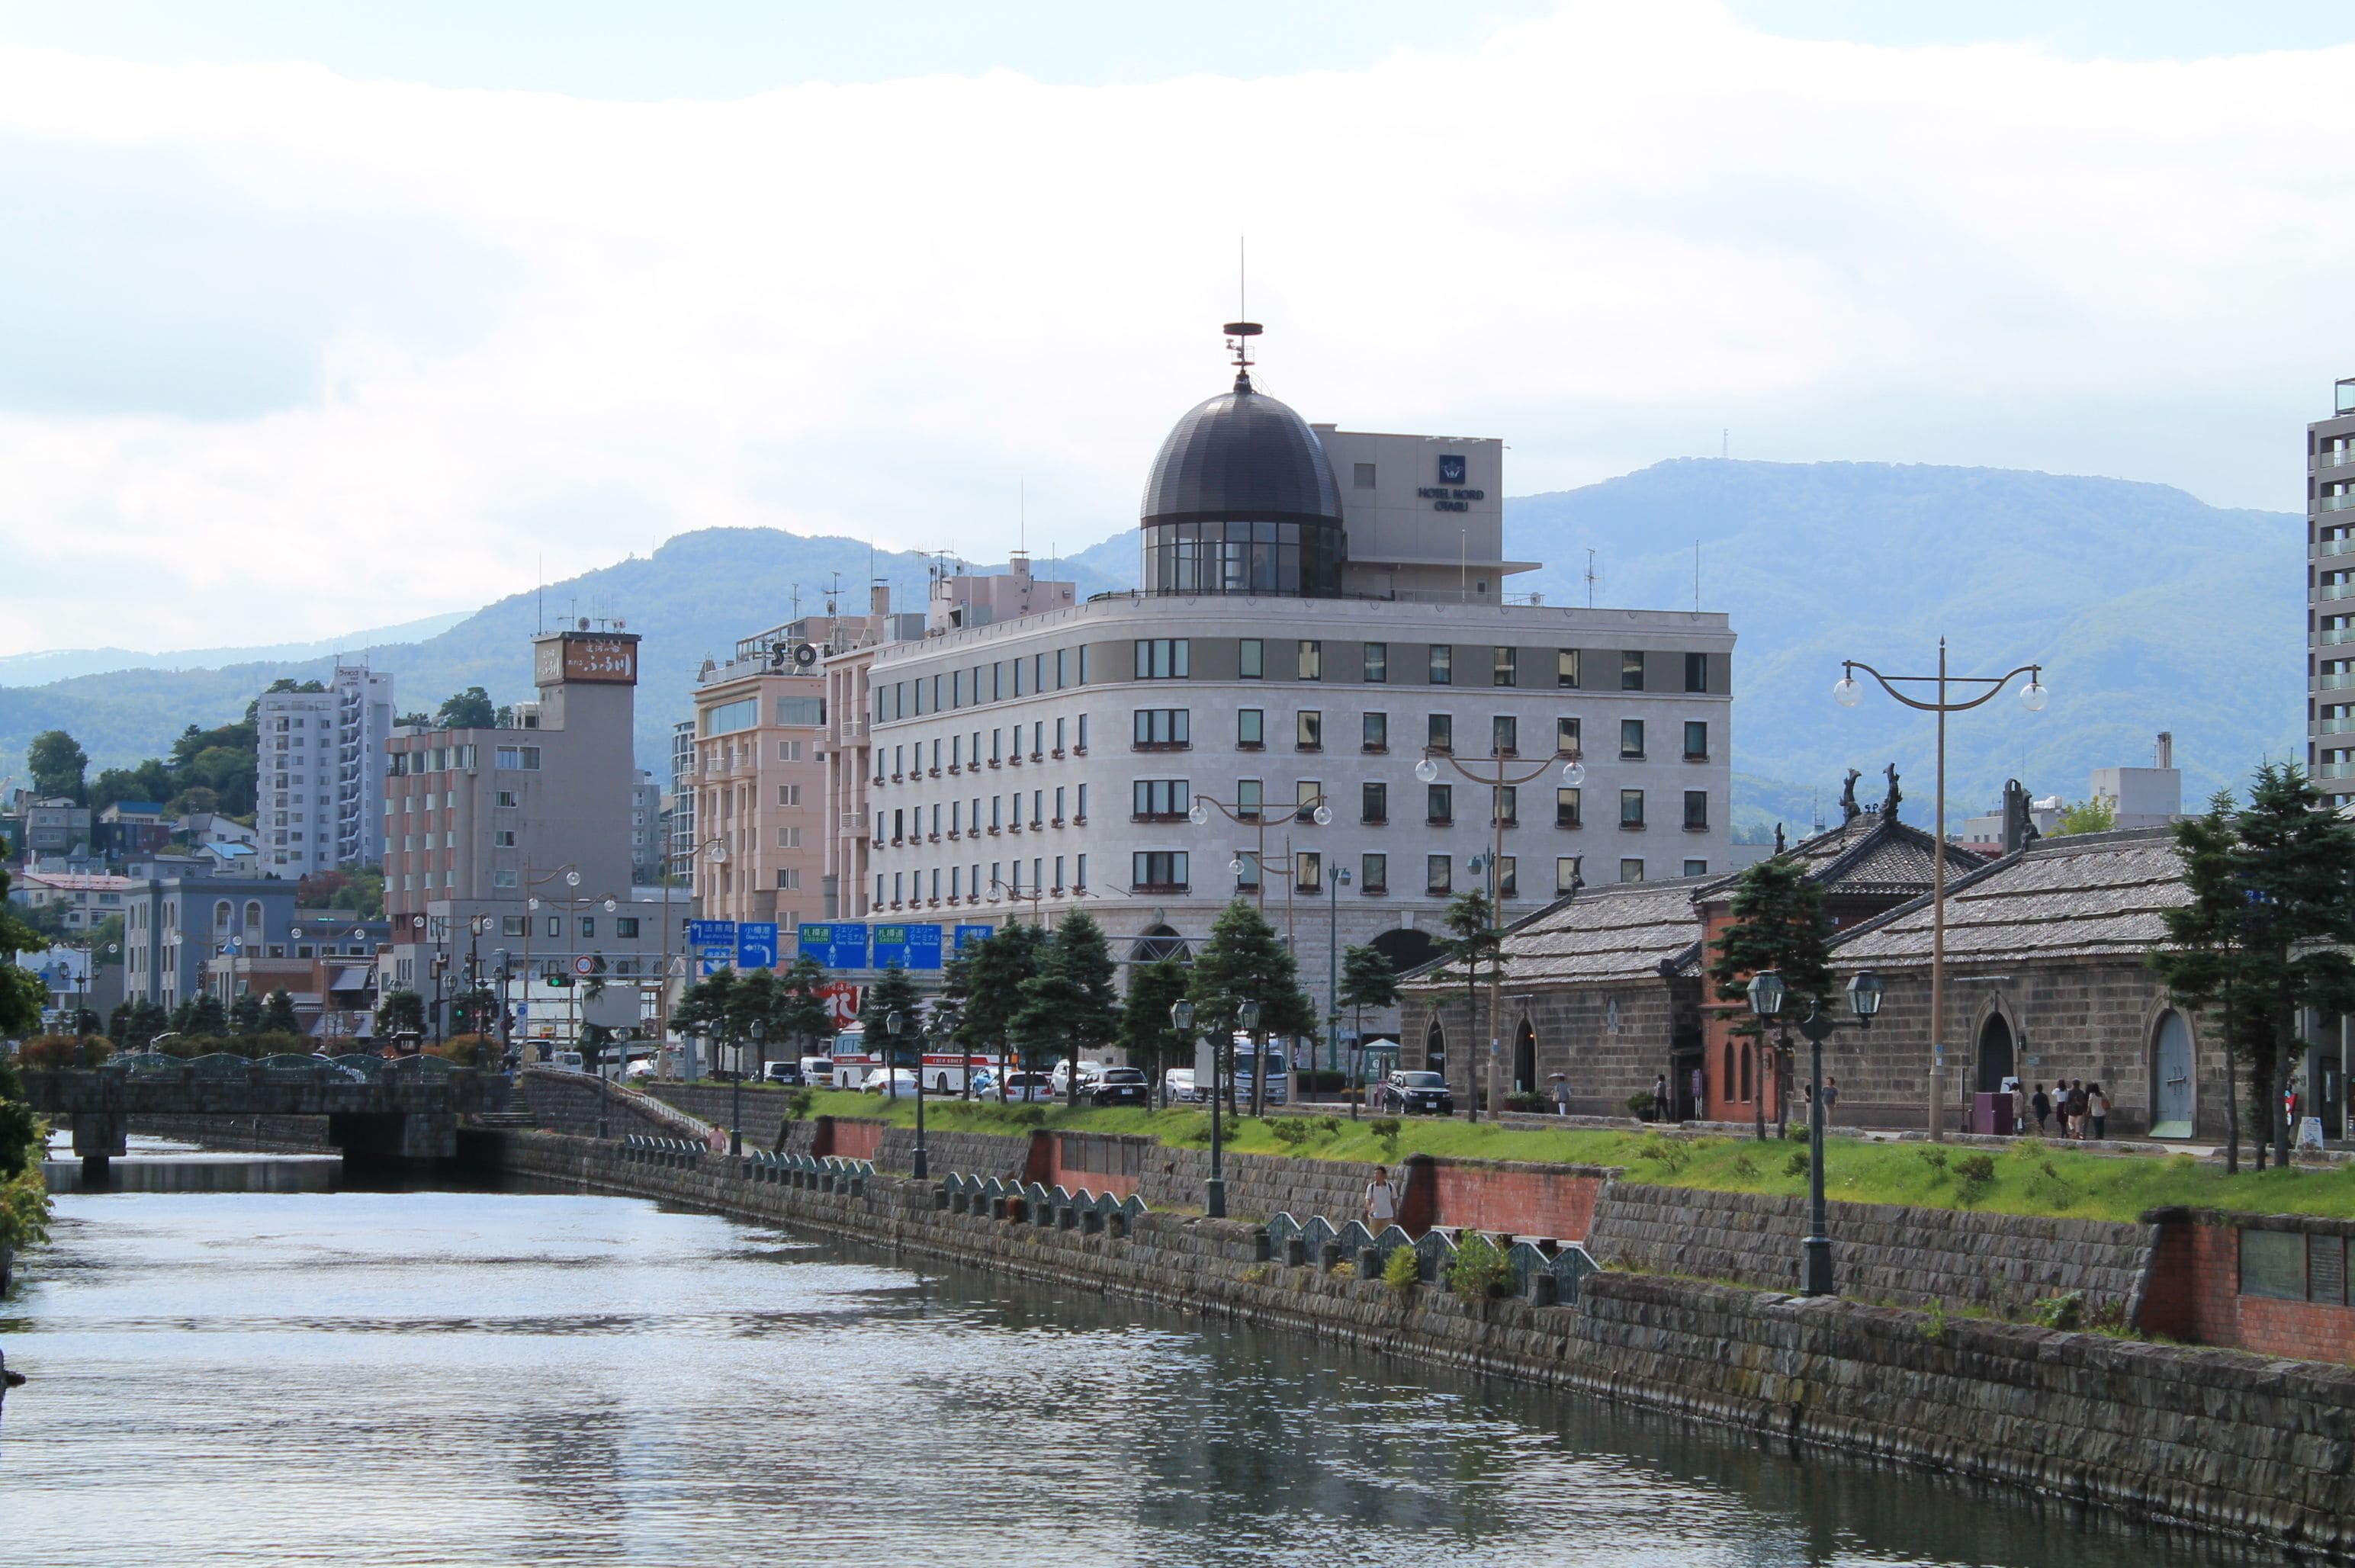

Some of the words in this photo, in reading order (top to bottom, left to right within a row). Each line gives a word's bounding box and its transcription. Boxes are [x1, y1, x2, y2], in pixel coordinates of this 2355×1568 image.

[1418, 487, 1451, 499] HOTEL
[1454, 489, 1484, 500] NORD
[1435, 500, 1468, 512] OTARU
[745, 926, 769, 934] 小樽港
[804, 928, 829, 937] 札樽道
[879, 929, 904, 937] 札樽道
